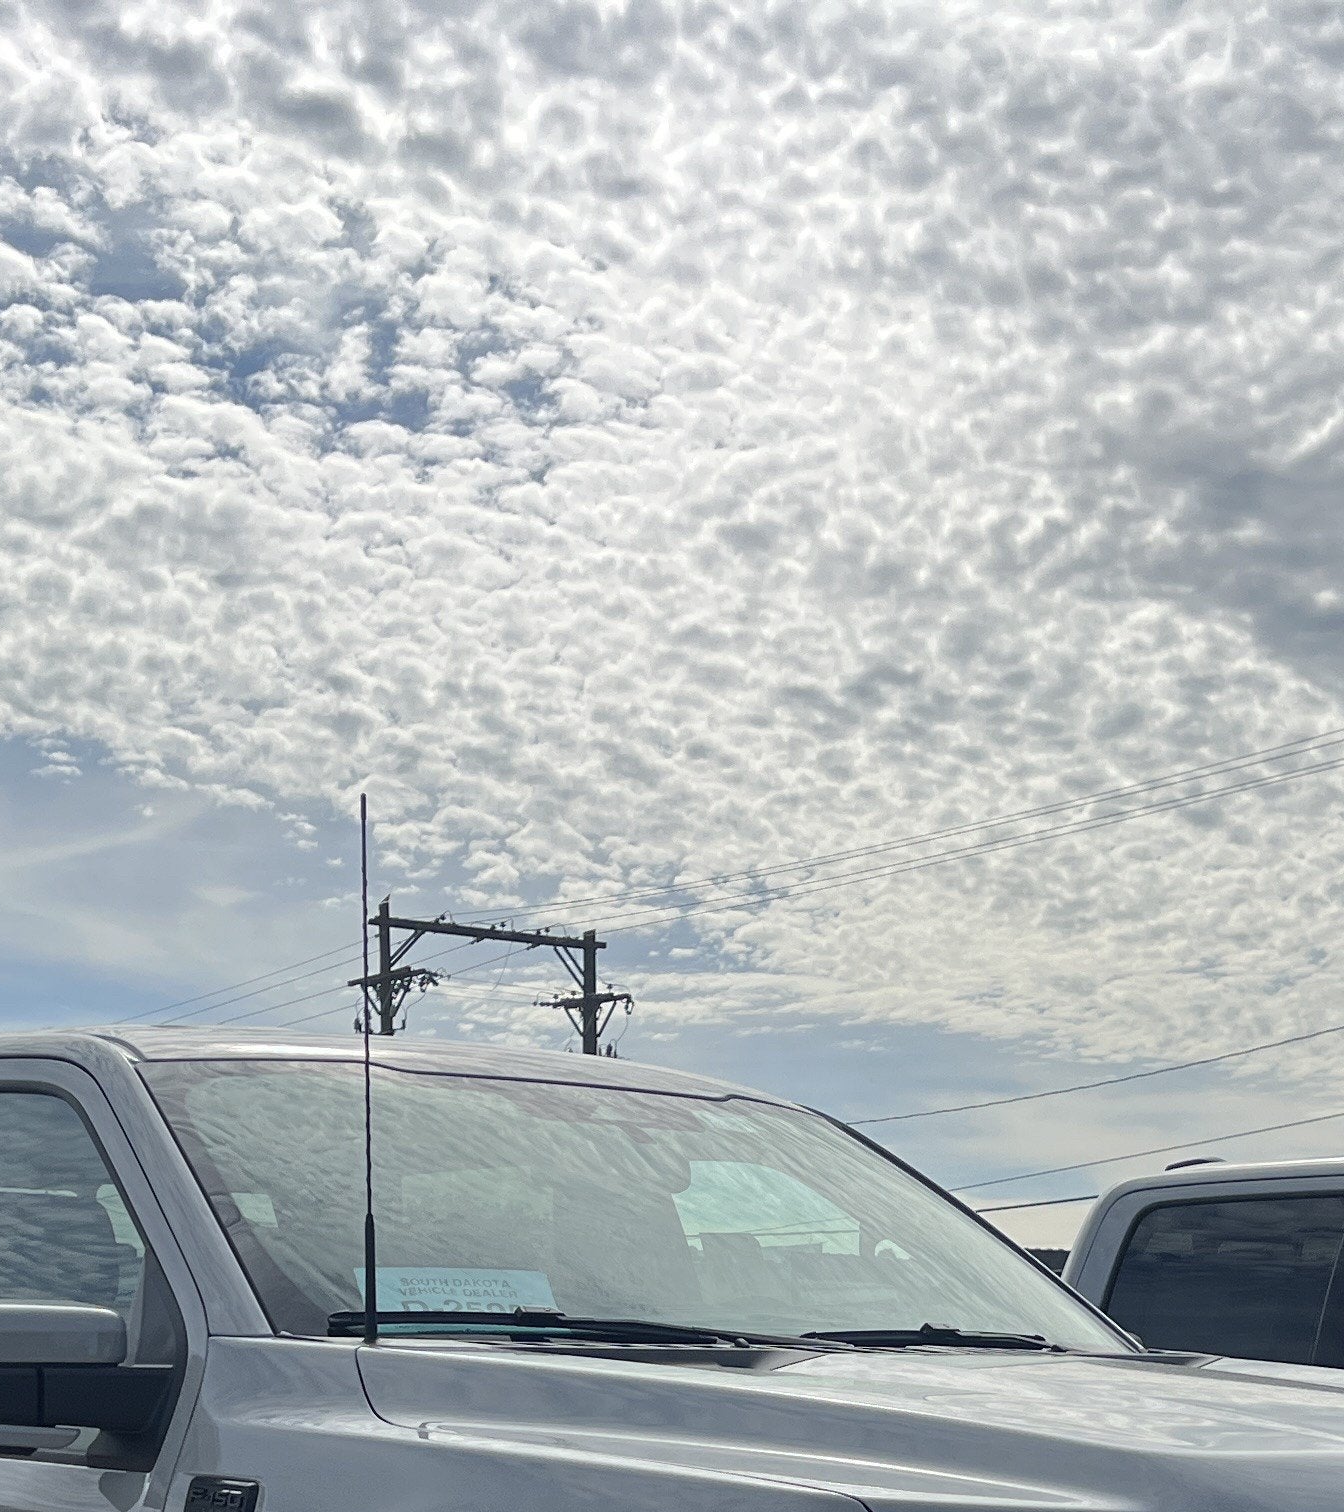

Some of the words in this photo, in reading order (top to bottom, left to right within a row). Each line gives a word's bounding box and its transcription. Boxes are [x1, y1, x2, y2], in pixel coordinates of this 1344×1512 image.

[399, 1277, 449, 1288] SOUTH
[452, 1278, 512, 1289] DAKOTA
[398, 1286, 456, 1297] VEHICLE
[461, 1287, 519, 1299] DEALER
